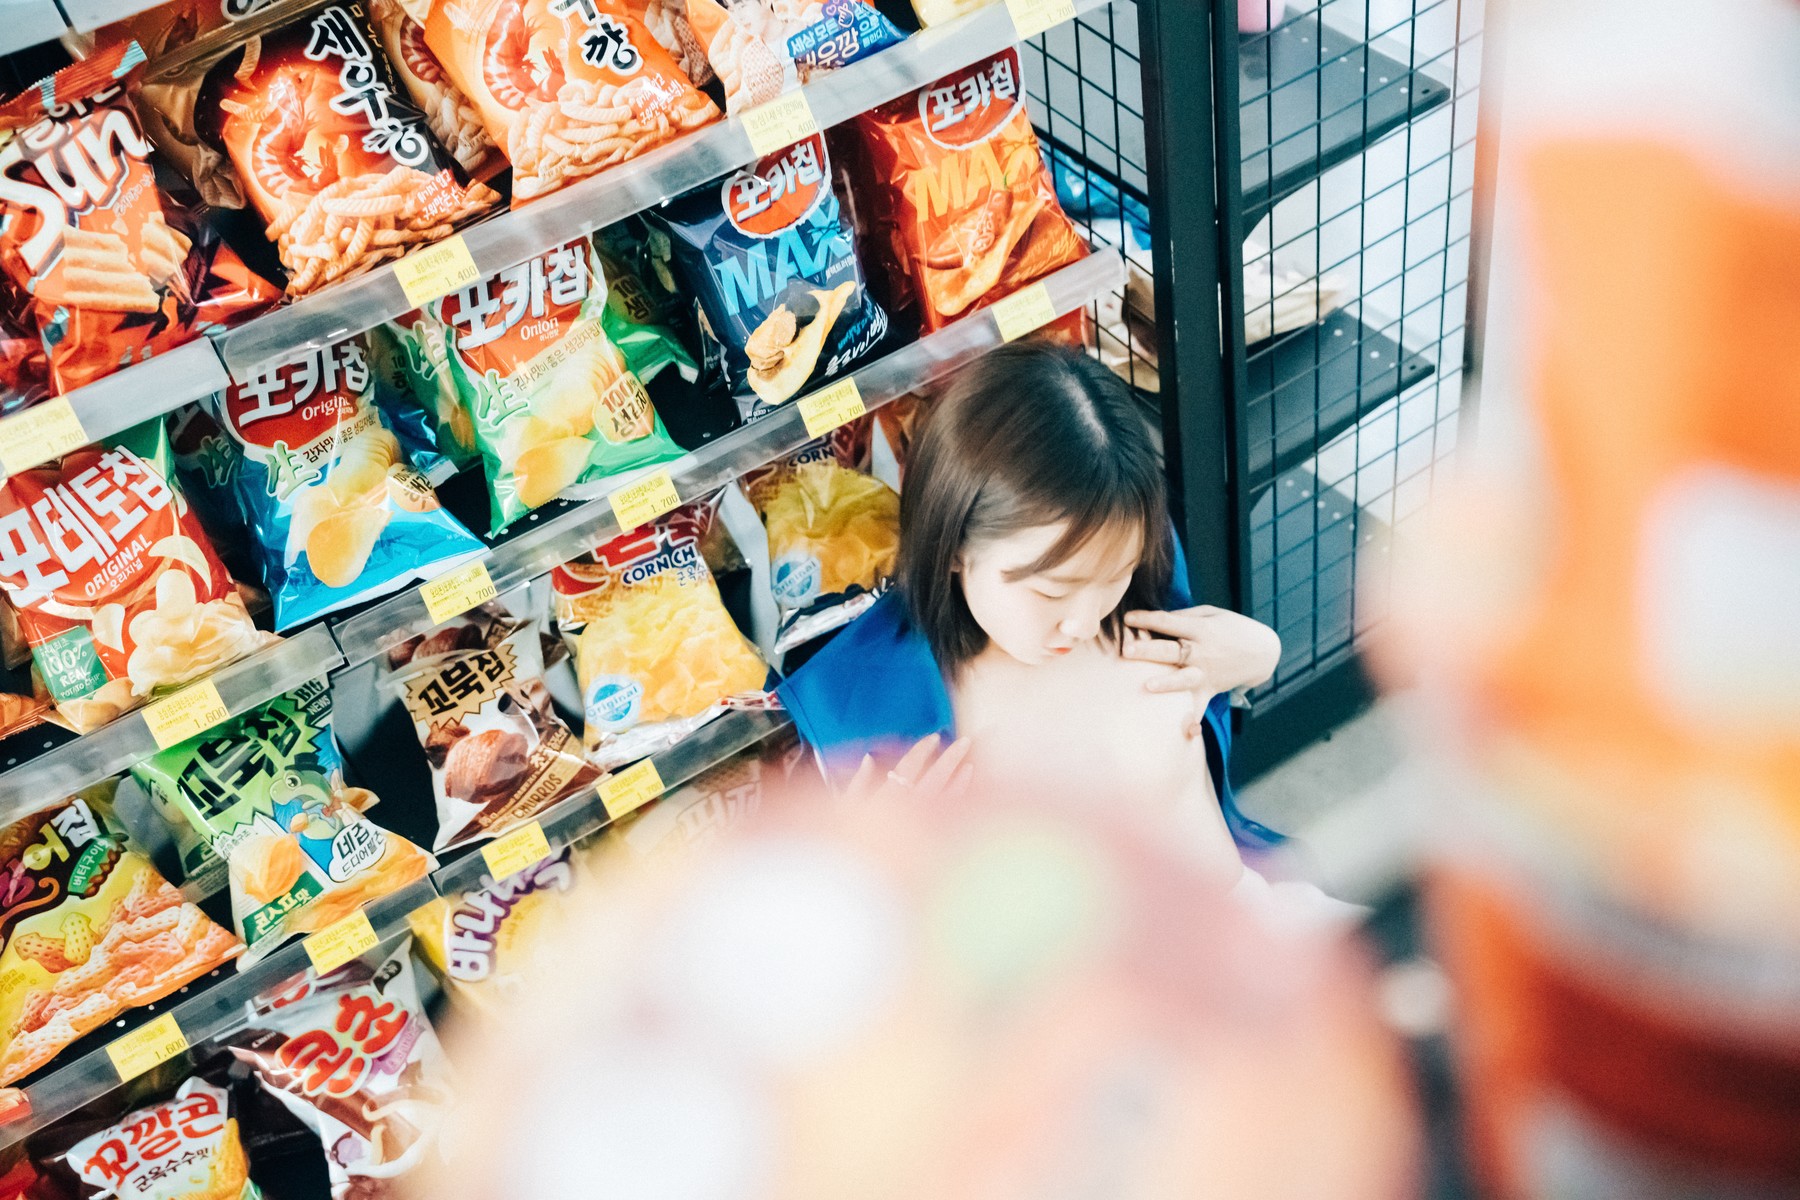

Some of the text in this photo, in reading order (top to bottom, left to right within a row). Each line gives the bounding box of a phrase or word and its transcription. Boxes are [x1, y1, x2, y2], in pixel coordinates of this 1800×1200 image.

[307, 7, 425, 163] 새우깡
[930, 58, 1017, 132] 포카칩
[0, 110, 151, 270] Sun
[736, 141, 823, 223] 포카칩
[713, 197, 854, 316] MAX
[452, 244, 590, 350] 포카칩
[520, 317, 559, 341] Onion
[238, 341, 369, 427] 포카칩
[0, 444, 173, 607] 포테토칩
[84, 533, 153, 597] ORIGINAL
[109, 557, 144, 592] 오리지널
[622, 546, 696, 586] CORN CH
[676, 563, 707, 587] 군옥수
[45, 643, 87, 678] 100%
[60, 668, 91, 687] REAL
[294, 677, 324, 703] BIG
[418, 650, 506, 716] 꼬북칩
[306, 694, 331, 716] NEWS
[588, 685, 638, 718] Original
[511, 772, 563, 819] CHURROS
[0, 798, 101, 908] 징어집
[84, 1092, 224, 1190] 꼬깔콘
[133, 1148, 209, 1192] 군옥수수맛
